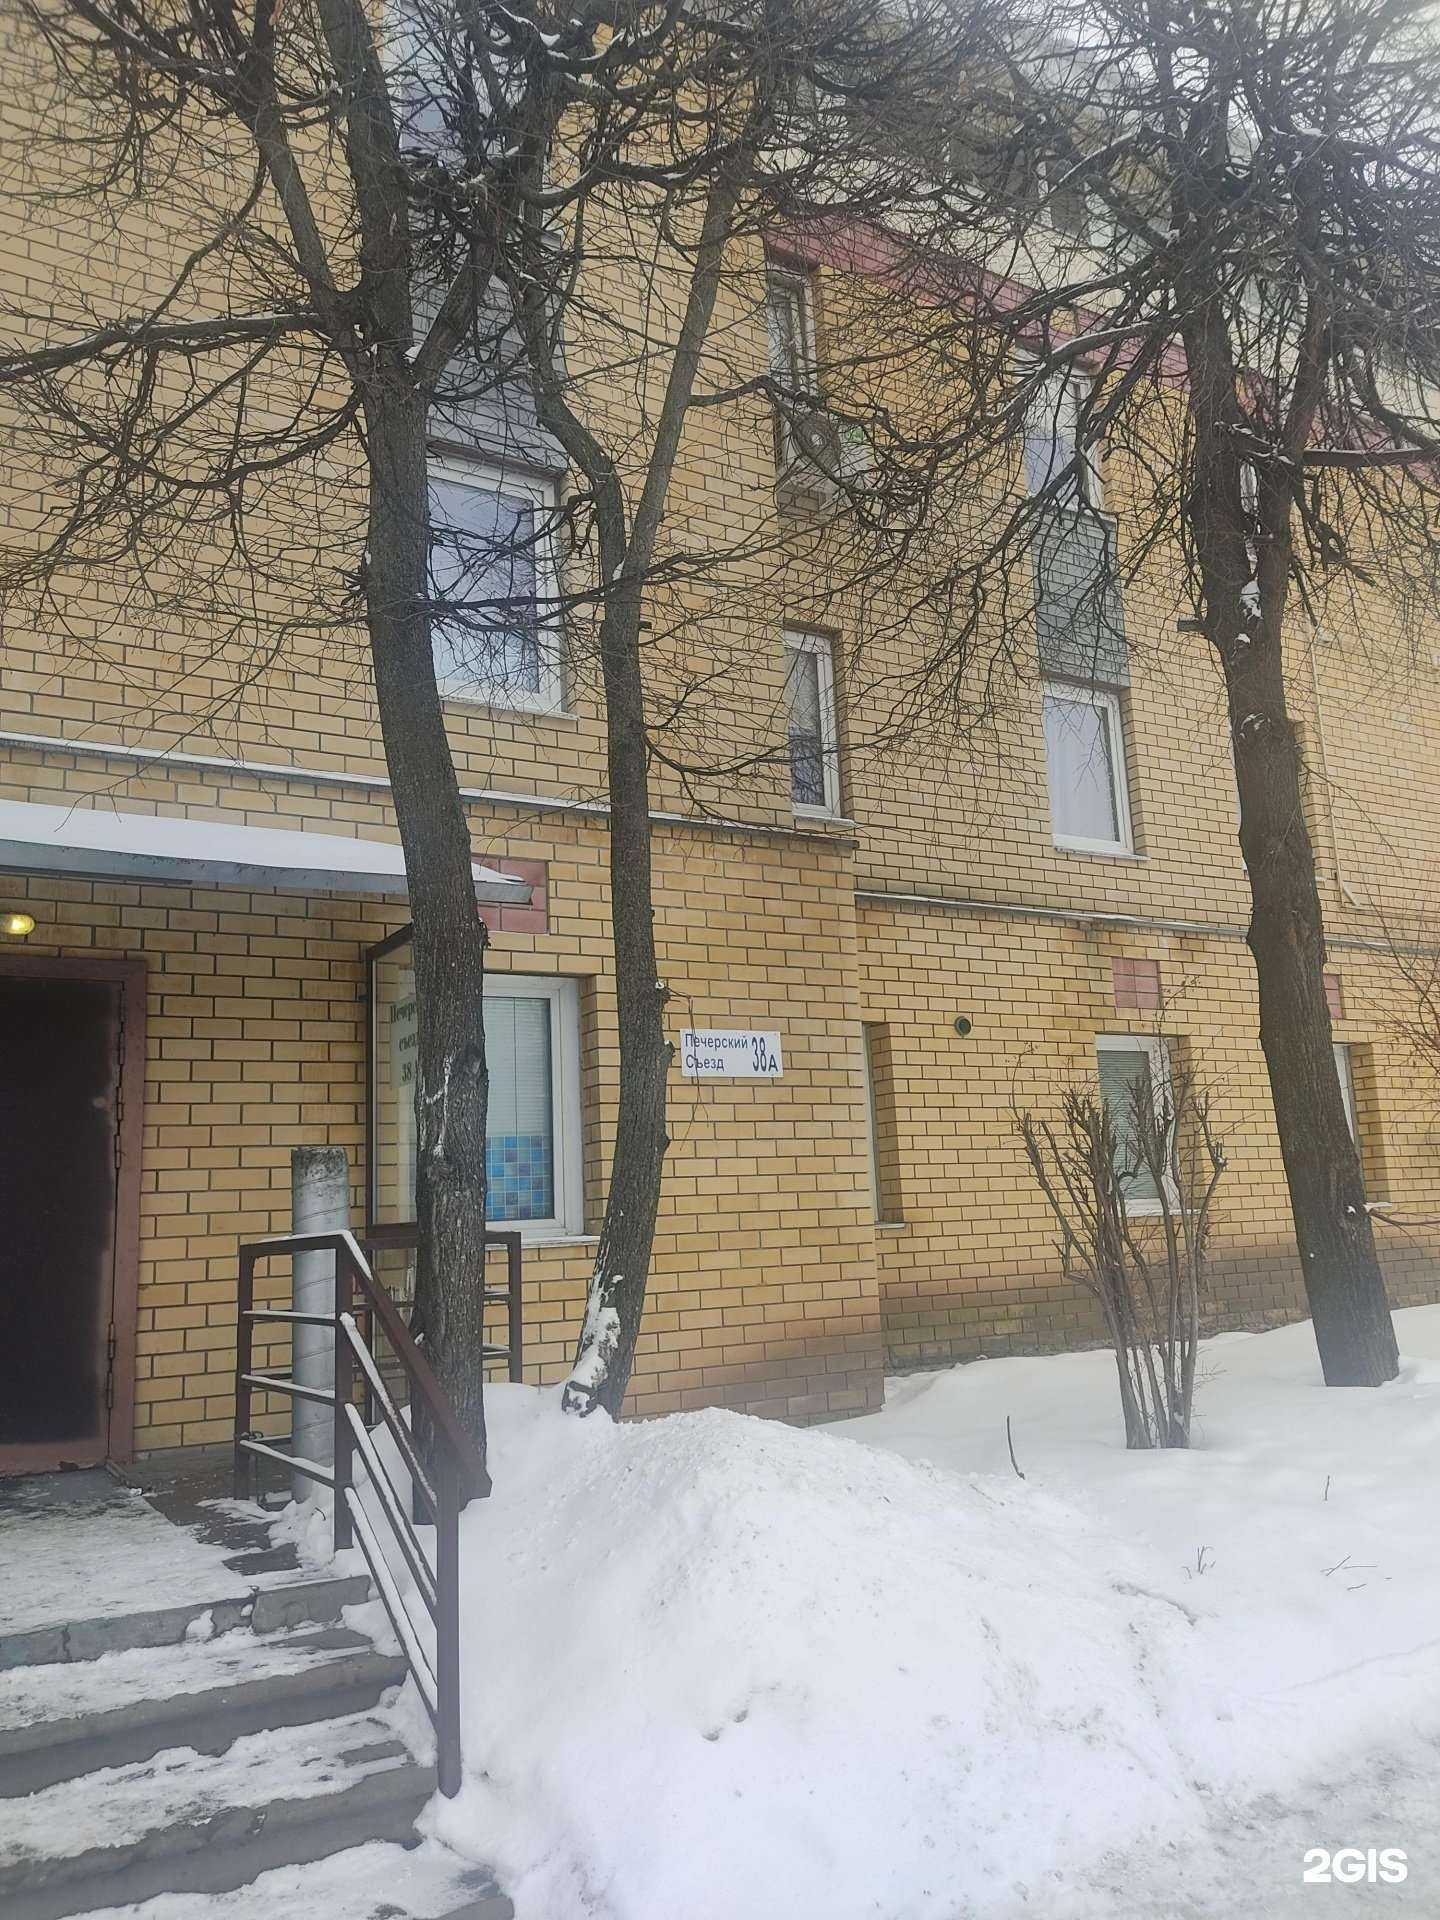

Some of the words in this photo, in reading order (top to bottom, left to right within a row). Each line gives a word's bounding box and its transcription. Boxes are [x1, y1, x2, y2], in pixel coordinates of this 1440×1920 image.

[685, 1033, 748, 1051] Печерский
[685, 1054, 725, 1072] Съезд
[751, 1036, 779, 1072] 38А
